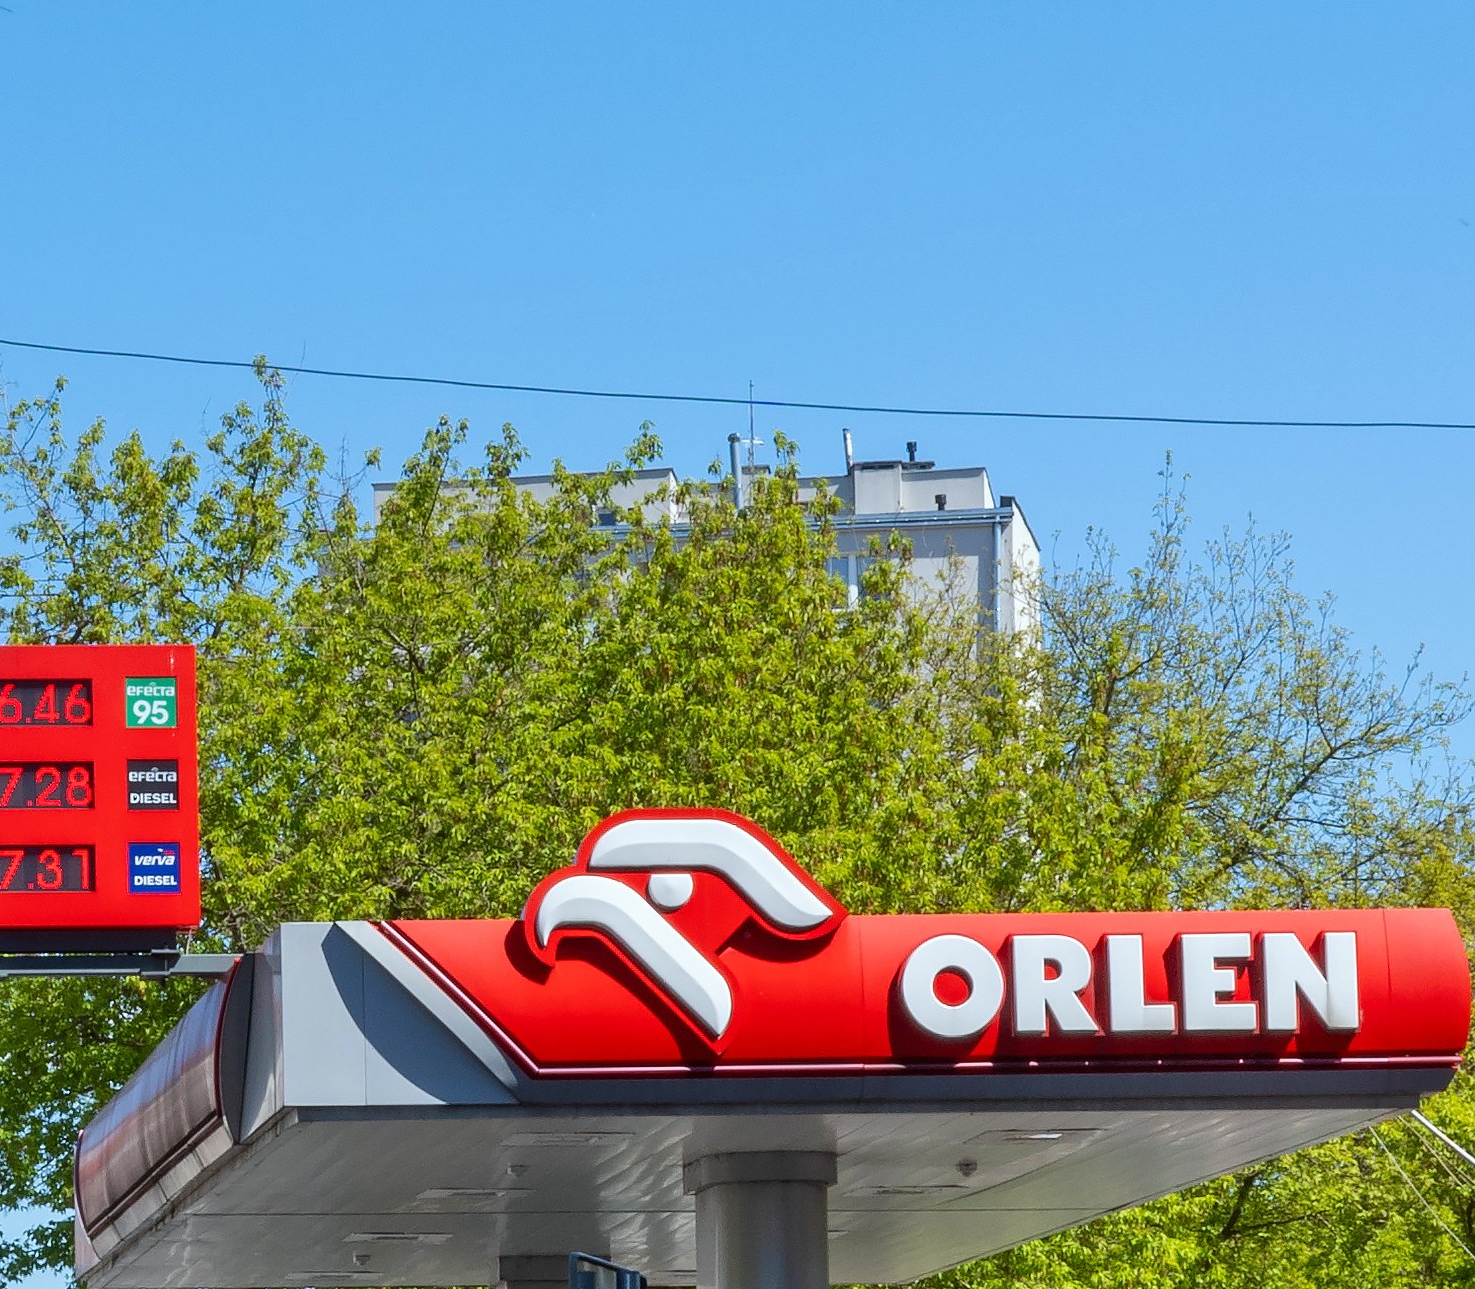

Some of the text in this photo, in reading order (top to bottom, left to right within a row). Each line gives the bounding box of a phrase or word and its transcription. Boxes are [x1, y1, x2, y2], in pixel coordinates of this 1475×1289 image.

[133, 700, 169, 725] 95
[130, 793, 177, 804] DIESEL
[134, 855, 175, 866] verva
[134, 875, 177, 886] DIESEL
[902, 931, 1360, 1038] ORLEN
